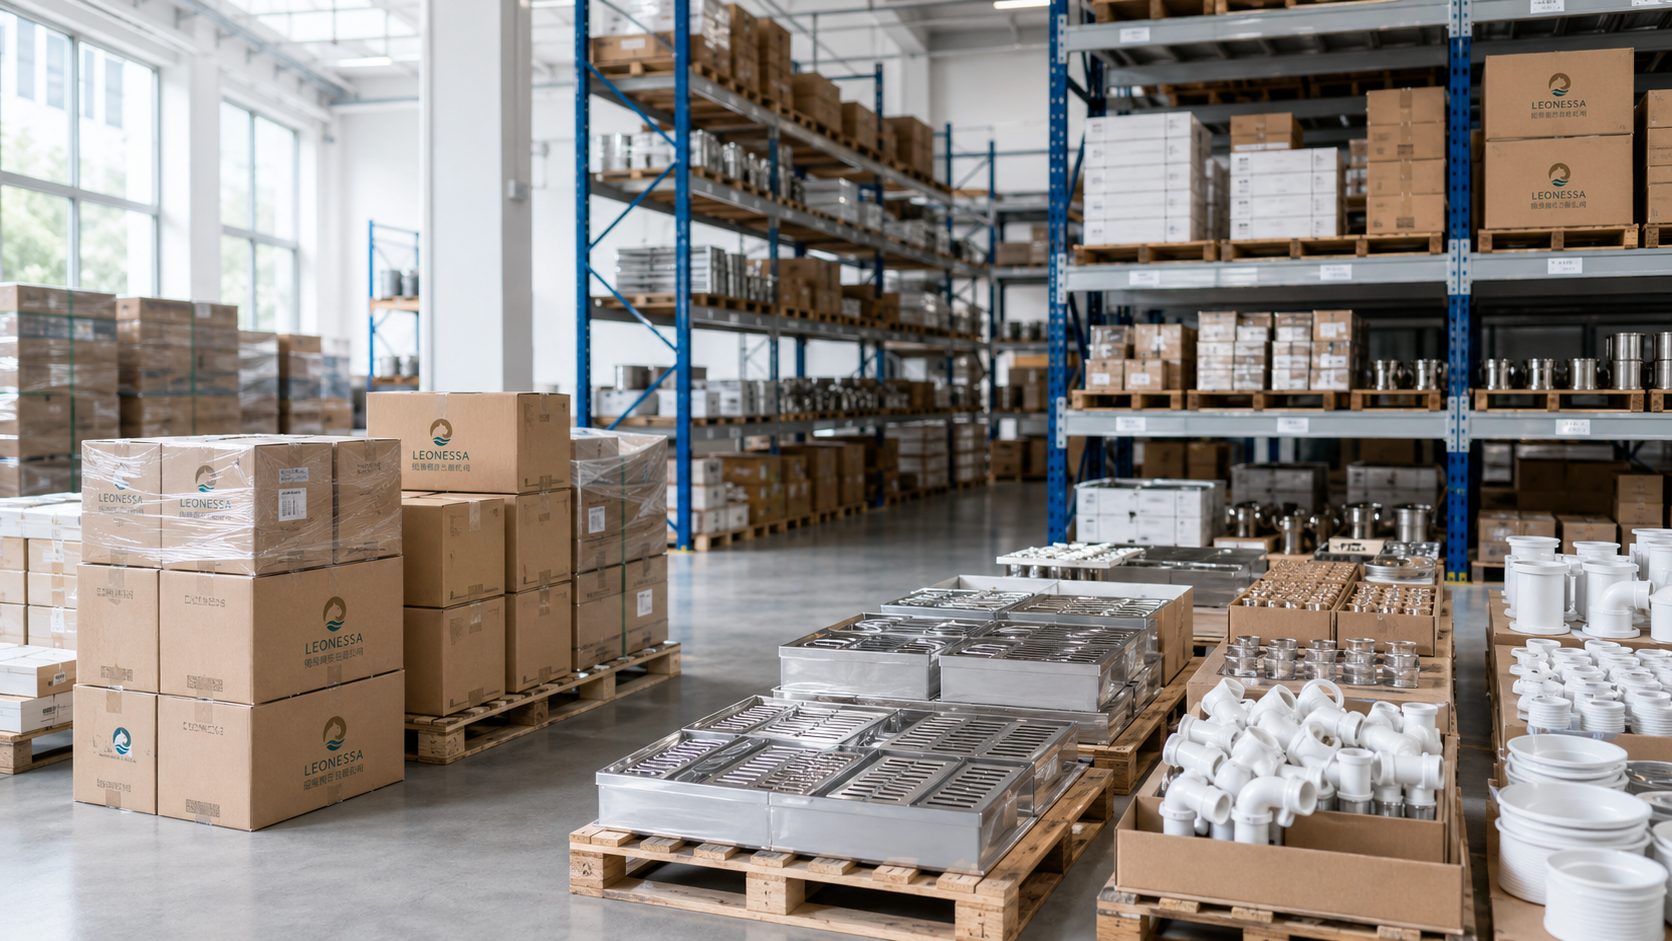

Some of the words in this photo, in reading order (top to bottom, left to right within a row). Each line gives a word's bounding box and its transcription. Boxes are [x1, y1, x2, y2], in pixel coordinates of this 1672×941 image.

[1531, 99, 1587, 110] LEONESSA
[1531, 190, 1586, 200] LEONESSA
[412, 450, 470, 461] LEONESSA
[98, 493, 143, 505] LEONESSA
[180, 498, 232, 509] LEONESSA
[305, 633, 363, 655] LEONESSA
[304, 749, 364, 776] LEONESSA
